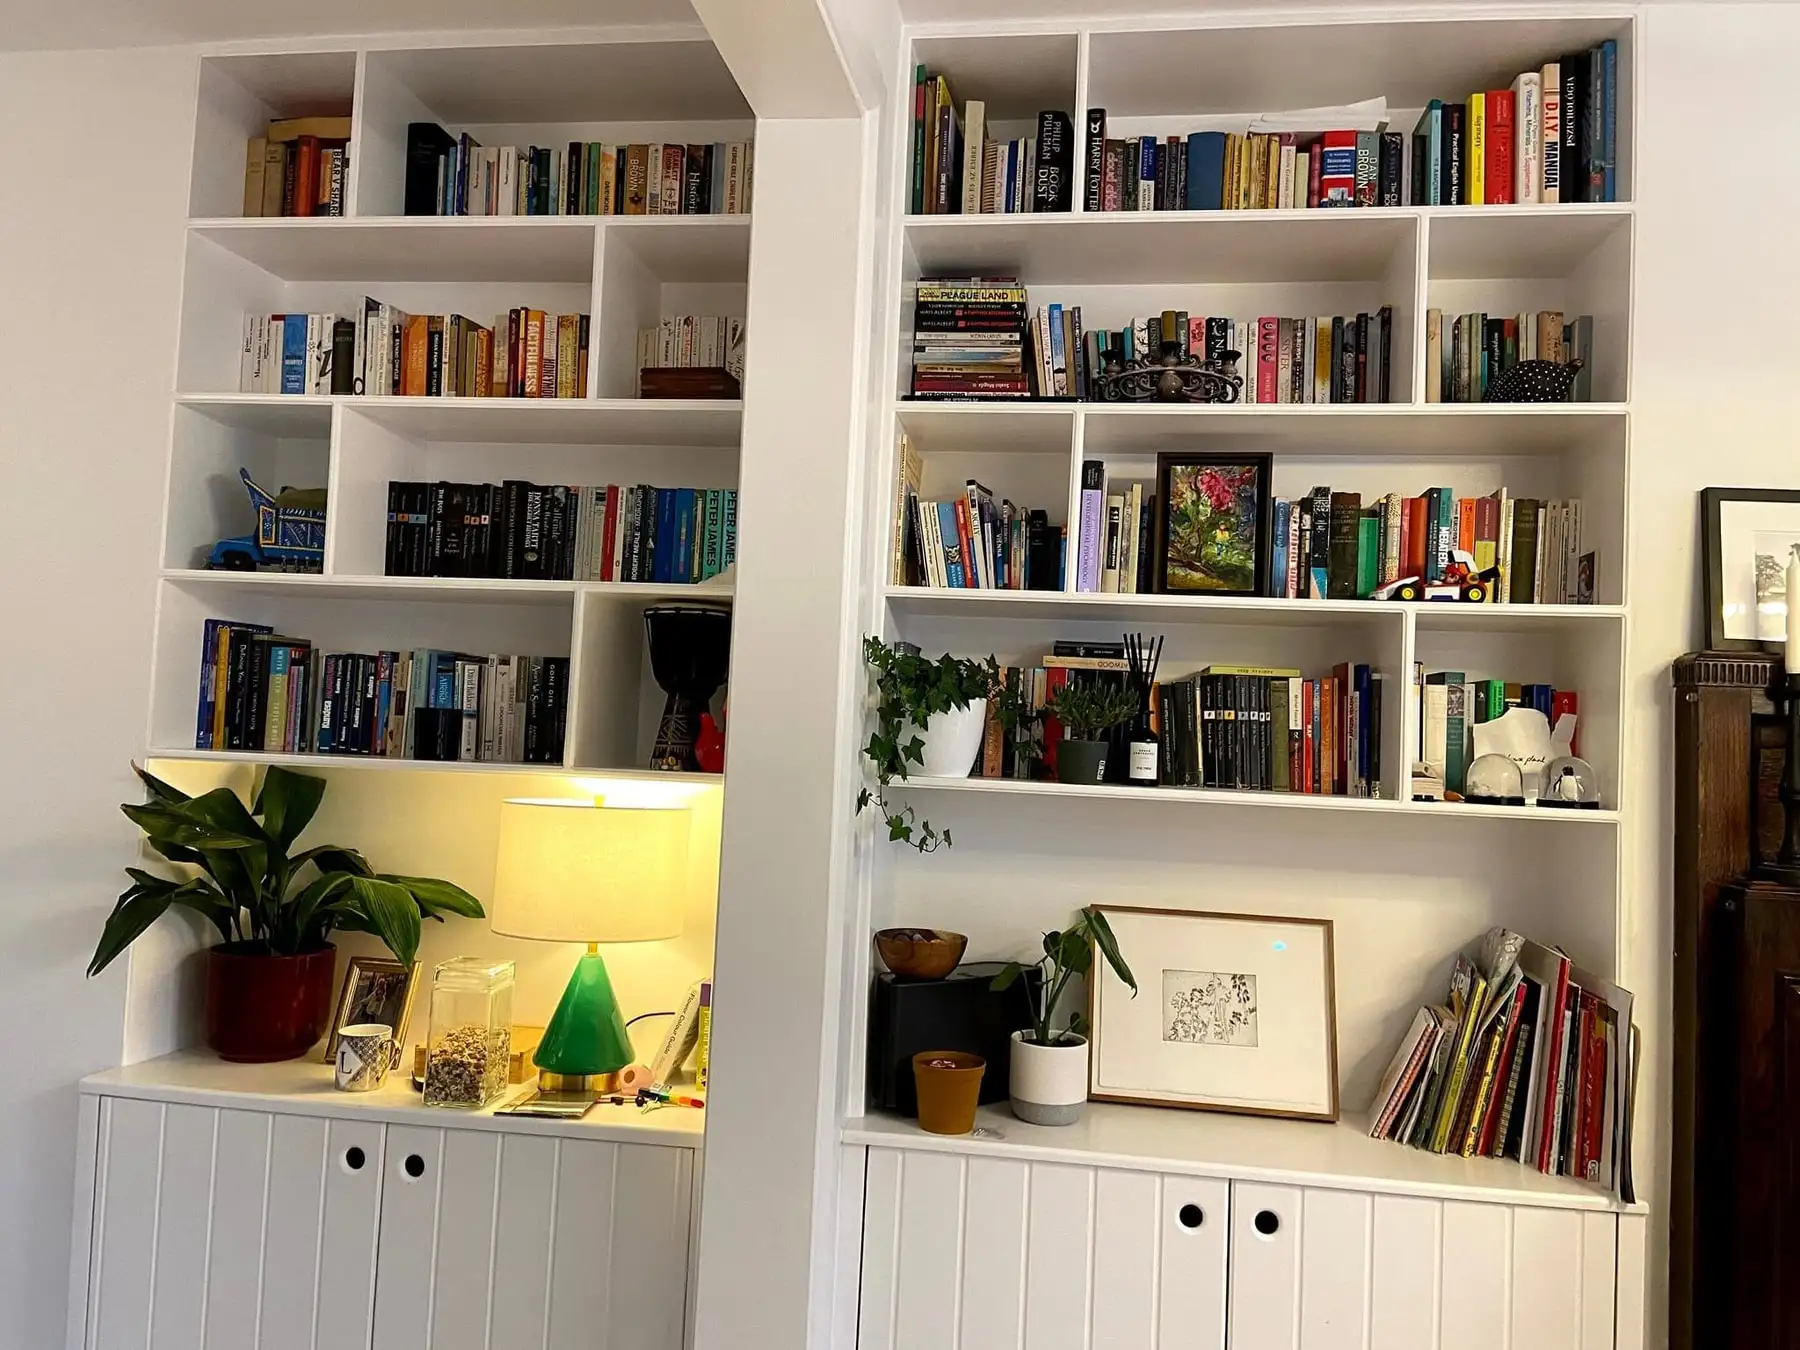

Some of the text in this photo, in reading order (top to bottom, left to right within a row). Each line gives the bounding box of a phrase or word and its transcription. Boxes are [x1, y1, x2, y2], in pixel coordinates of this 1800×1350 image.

[1042, 114, 1053, 160] PULLMAN
[1052, 121, 1062, 153] PHILIP
[1524, 119, 1533, 146] Minerals
[1544, 102, 1559, 190] D.I.Y. MANUAL
[333, 150, 342, 175] BEAR
[629, 159, 639, 191] BROWN
[671, 151, 681, 181] SCARLETT
[1089, 138, 1103, 211] HARRY POTTER
[1106, 152, 1118, 182] cloud
[1357, 149, 1369, 189] BROWN
[1369, 157, 1377, 180] DAN
[1523, 157, 1533, 198] Supplements
[1038, 169, 1049, 199] DUST
[1048, 166, 1060, 202] BOOK
[1450, 186, 1458, 206] Usage
[330, 187, 339, 217] SHARK
[940, 291, 1009, 301] PLAGUE LAND
[524, 321, 540, 392] FACTFULNESS
[1264, 322, 1275, 362] glue
[1280, 337, 1289, 371] SISTER
[530, 491, 542, 549] DONNA TARTT
[706, 490, 719, 567] PETER JAMES
[724, 490, 737, 567] PETER JAMES
[632, 532, 640, 553] MERLE
[1082, 493, 1093, 585] DEVELOPMENTAL PSYCHOLOGY
[1437, 526, 1449, 568] MEGATECH
[631, 555, 639, 581] ROBERT
[237, 644, 247, 683] Defining You
[276, 649, 284, 671] WHITE
[548, 664, 556, 686] GONE
[1097, 661, 1128, 669] ATWOOD
[438, 676, 448, 705] Allende
[321, 700, 333, 729] Kundera
[663, 992, 696, 1055] Flower Colour Guide
[339, 1050, 353, 1074] L
